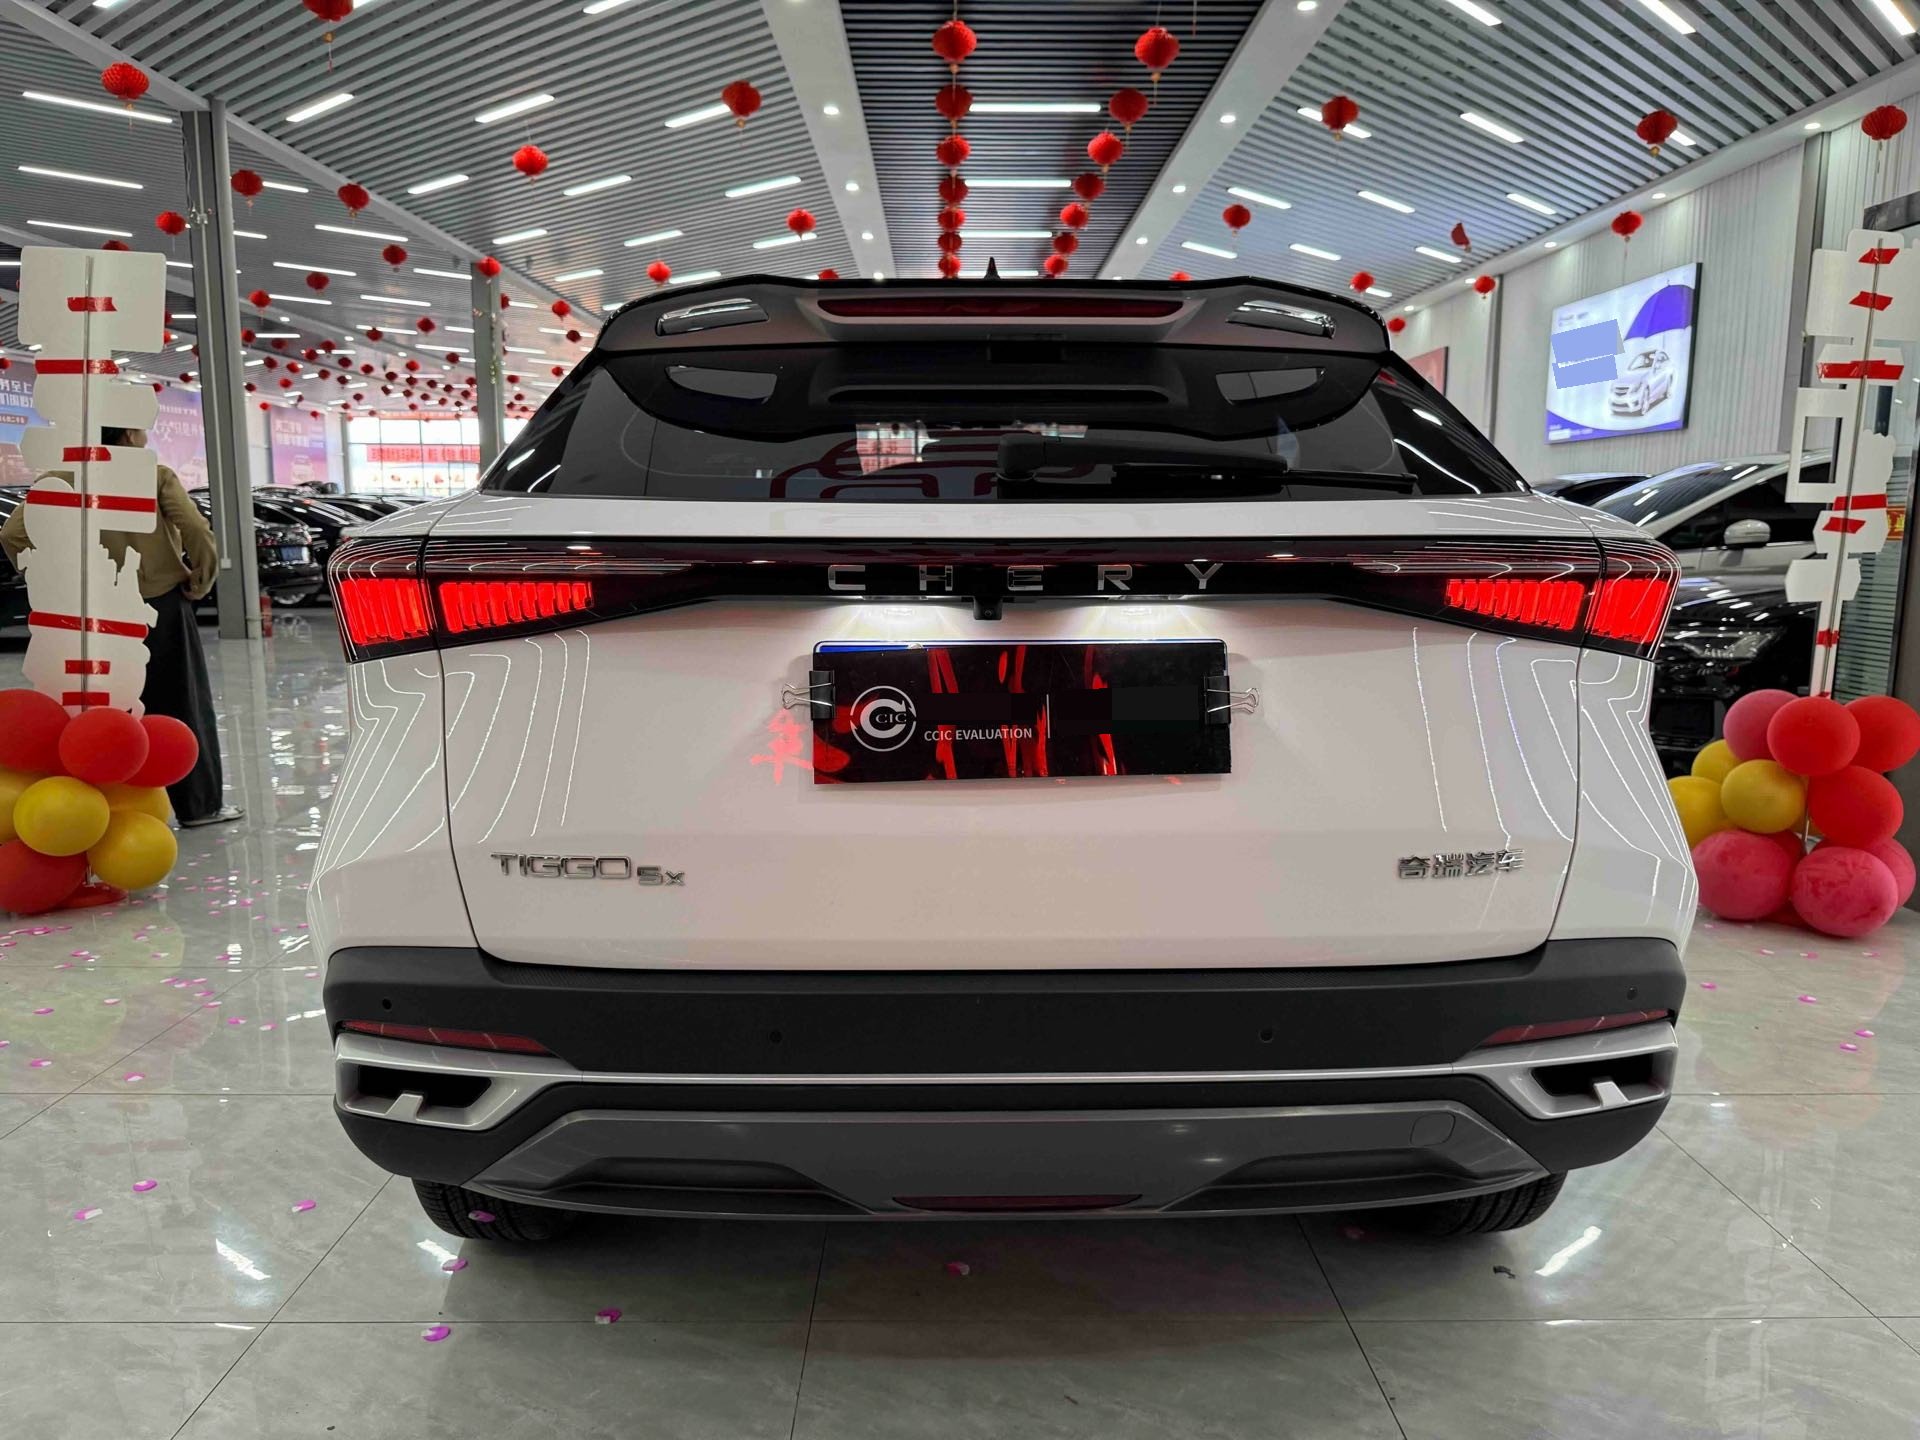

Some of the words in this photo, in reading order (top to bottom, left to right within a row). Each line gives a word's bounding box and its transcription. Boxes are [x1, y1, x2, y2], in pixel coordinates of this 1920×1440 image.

[828, 562, 1223, 591] CHERY
[924, 730, 952, 741] CCIC
[955, 727, 1032, 740] EVALUATION
[490, 852, 632, 879] TIGGO
[1398, 849, 1525, 879] 奇瑞汽车
